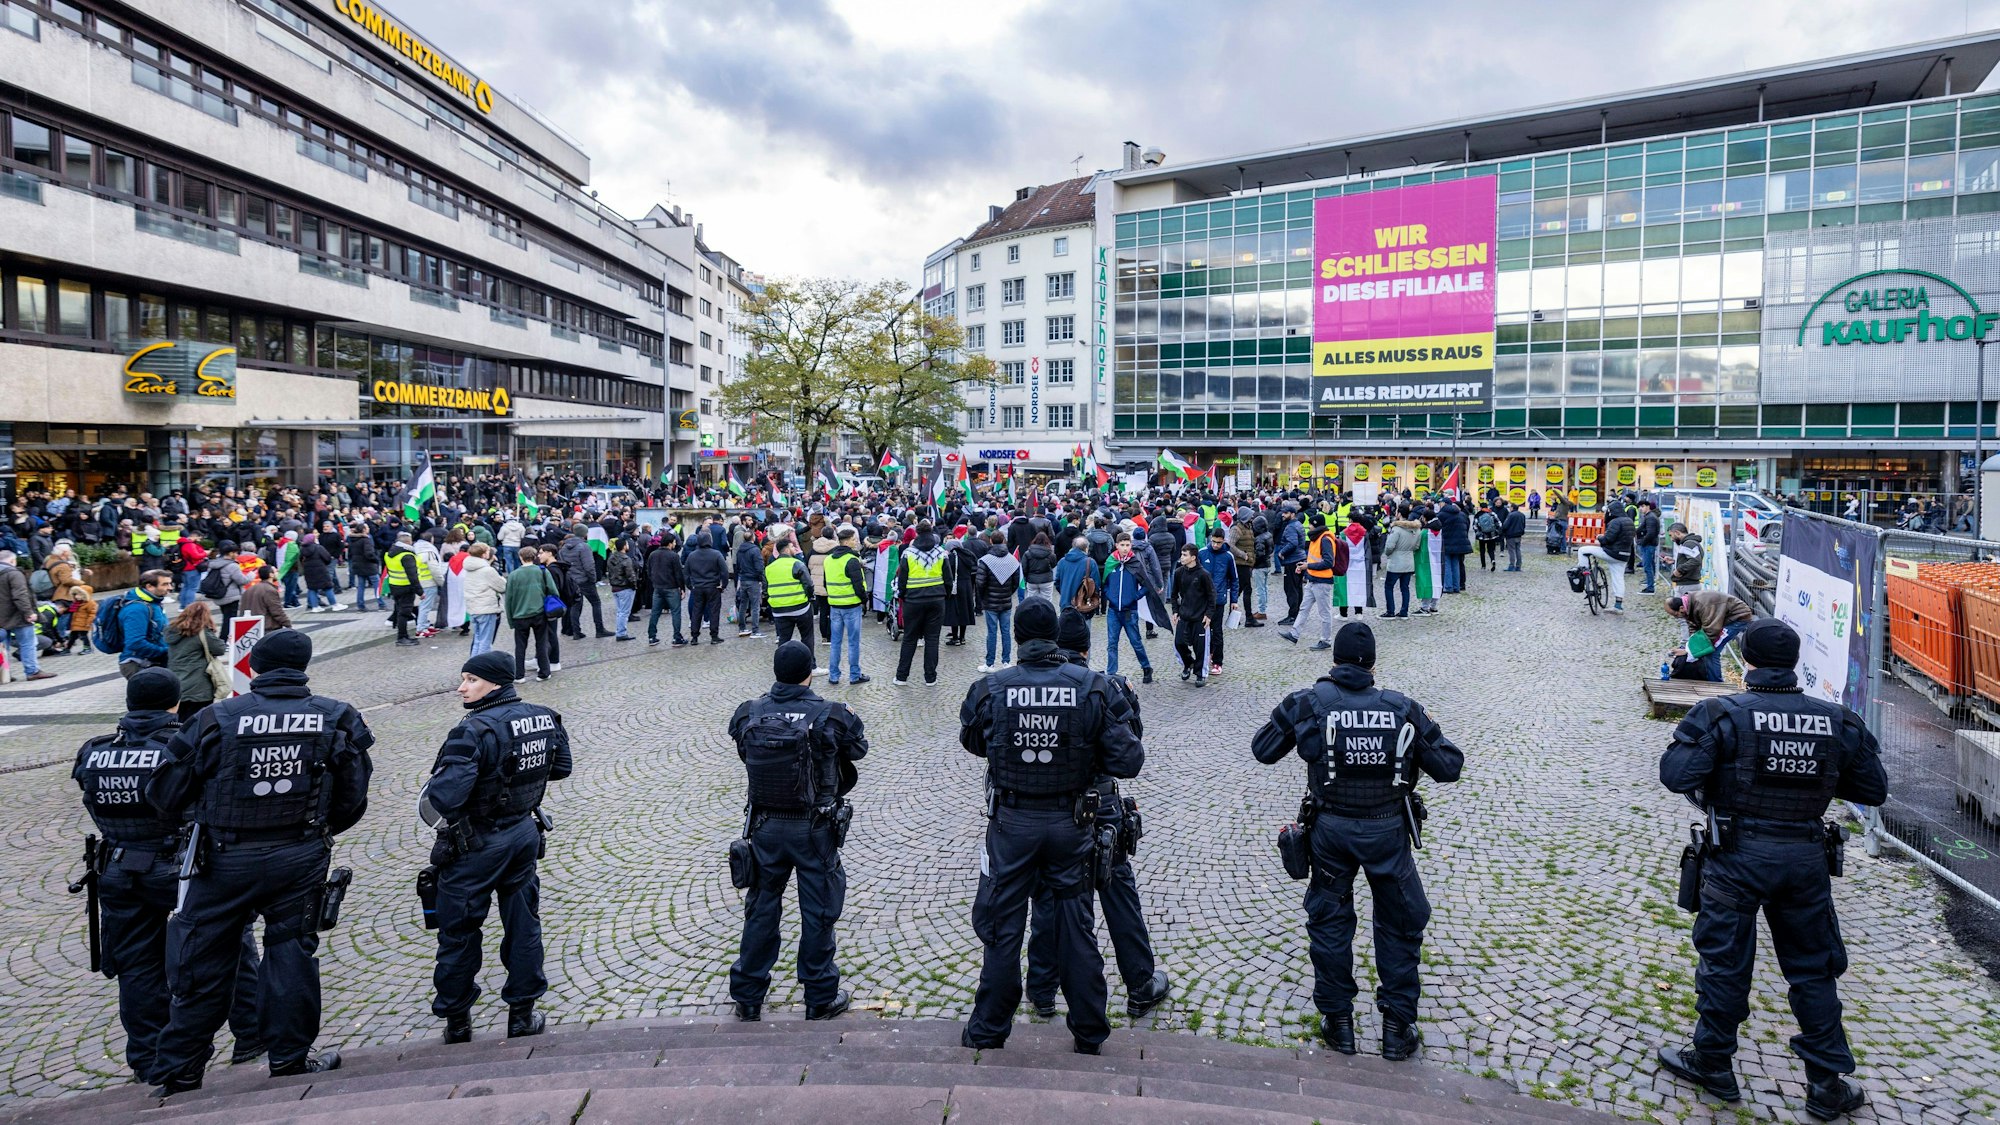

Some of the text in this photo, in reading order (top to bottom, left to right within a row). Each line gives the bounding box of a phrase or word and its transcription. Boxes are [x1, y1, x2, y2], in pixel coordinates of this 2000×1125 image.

[1375, 224, 1427, 248] WIR
[1321, 243, 1487, 279] SCHLIESSEN
[1323, 272, 1484, 303] DIESE FILIALE
[1845, 287, 1929, 312] GALERIA
[1323, 345, 1482, 365] ALLES MUSS RAUS
[374, 380, 490, 410] COMMERZBANK
[1322, 383, 1482, 401] ALLES REDUZIERT
[1007, 687, 1076, 707] POLIZEI
[237, 714, 323, 735] POLIZEI
[511, 715, 555, 736] POLIZEI
[1019, 713, 1058, 730] NRW
[1330, 711, 1396, 728] POLIZEI
[1754, 712, 1832, 735] POLIZEI
[522, 738, 546, 755] NRW
[1014, 732, 1058, 747] 31332
[1346, 736, 1383, 750] NRW
[1770, 740, 1816, 756] NRW
[86, 750, 160, 768] POLIZEI
[251, 745, 301, 763] NRW
[519, 753, 546, 770] 31331
[1346, 752, 1386, 764] 31332
[250, 760, 302, 778] 31331
[1767, 757, 1817, 774] 31332
[99, 776, 139, 790] NRW
[96, 791, 139, 804] 31331
